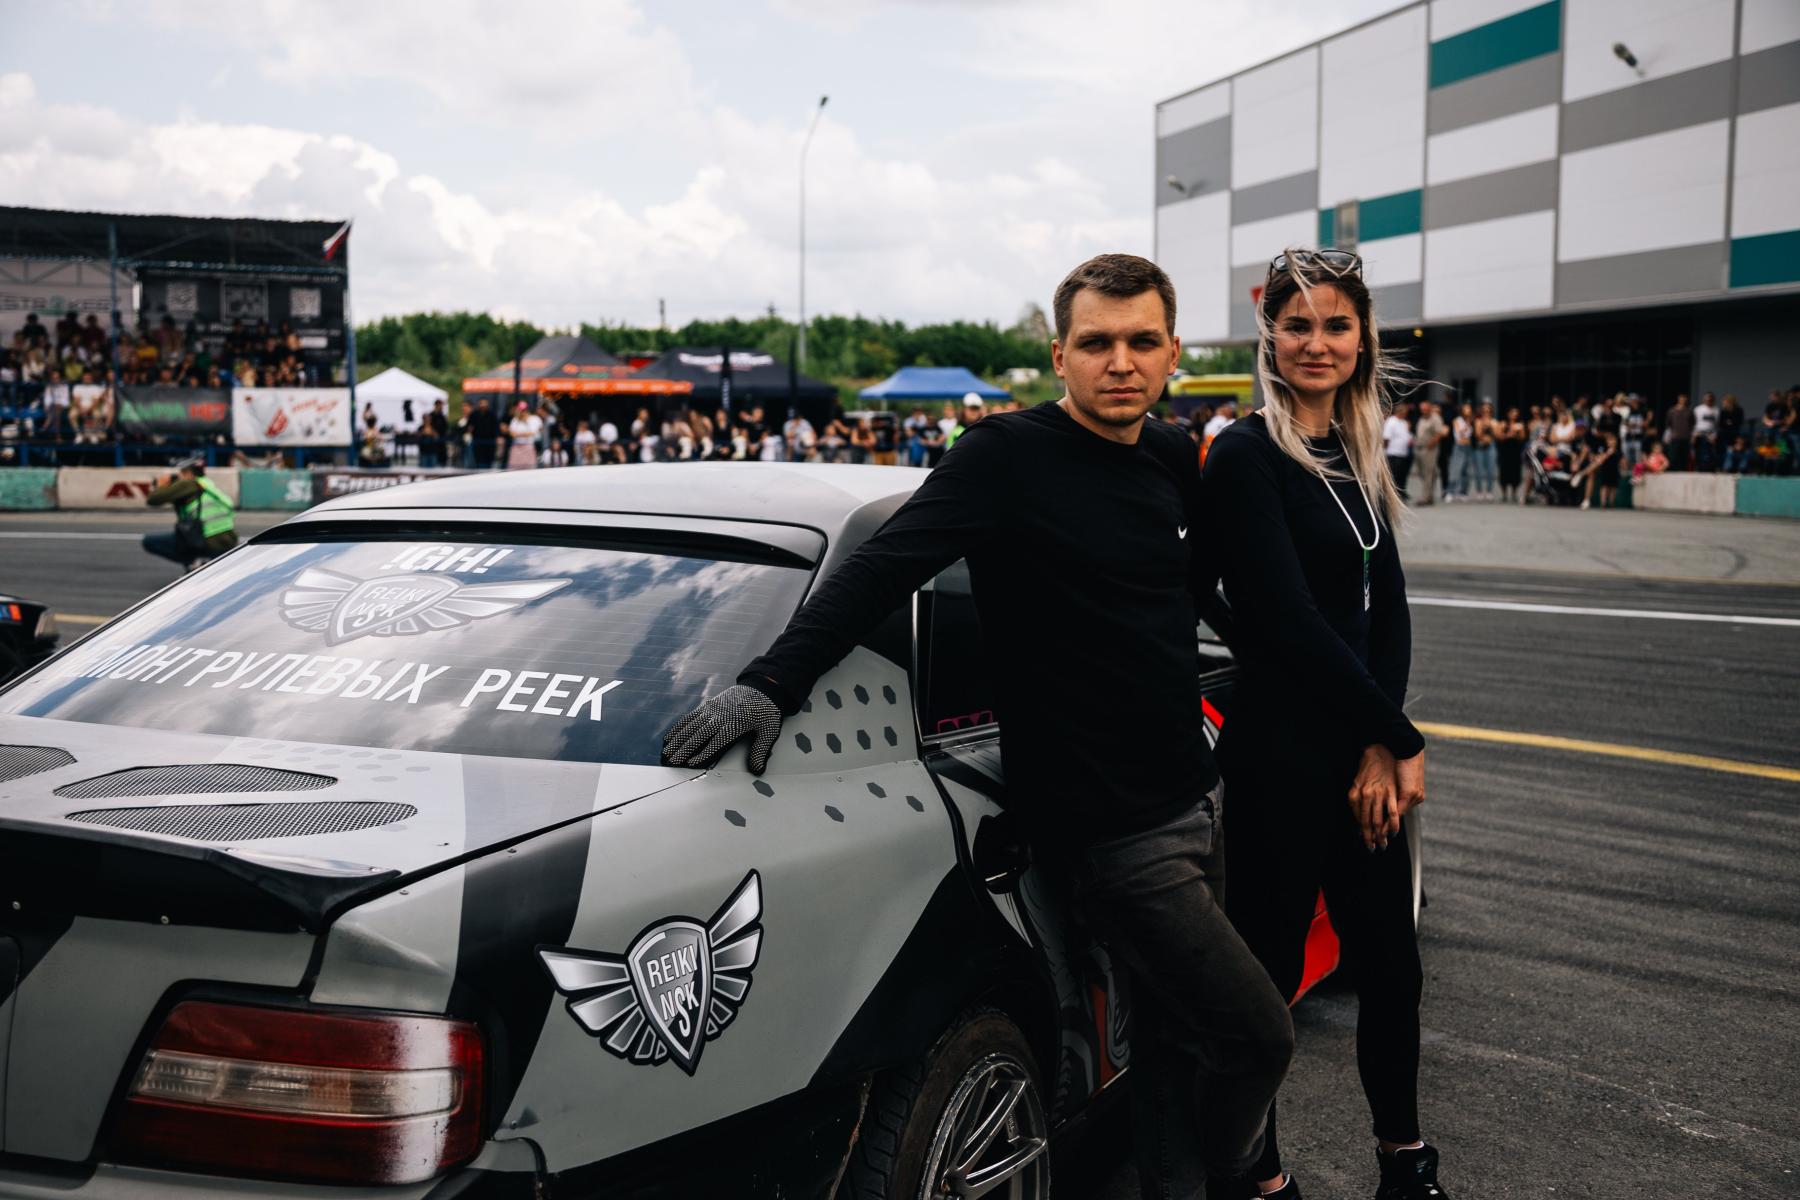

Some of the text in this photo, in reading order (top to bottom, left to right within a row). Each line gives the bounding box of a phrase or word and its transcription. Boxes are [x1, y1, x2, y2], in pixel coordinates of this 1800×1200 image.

[352, 602, 404, 628] NSK
[363, 586, 431, 601] REIKI
[183, 650, 451, 704] РУЛЕВЫХ
[459, 667, 625, 722] РЕЕК
[646, 945, 698, 988] REIKI
[660, 981, 699, 1038] NSK
